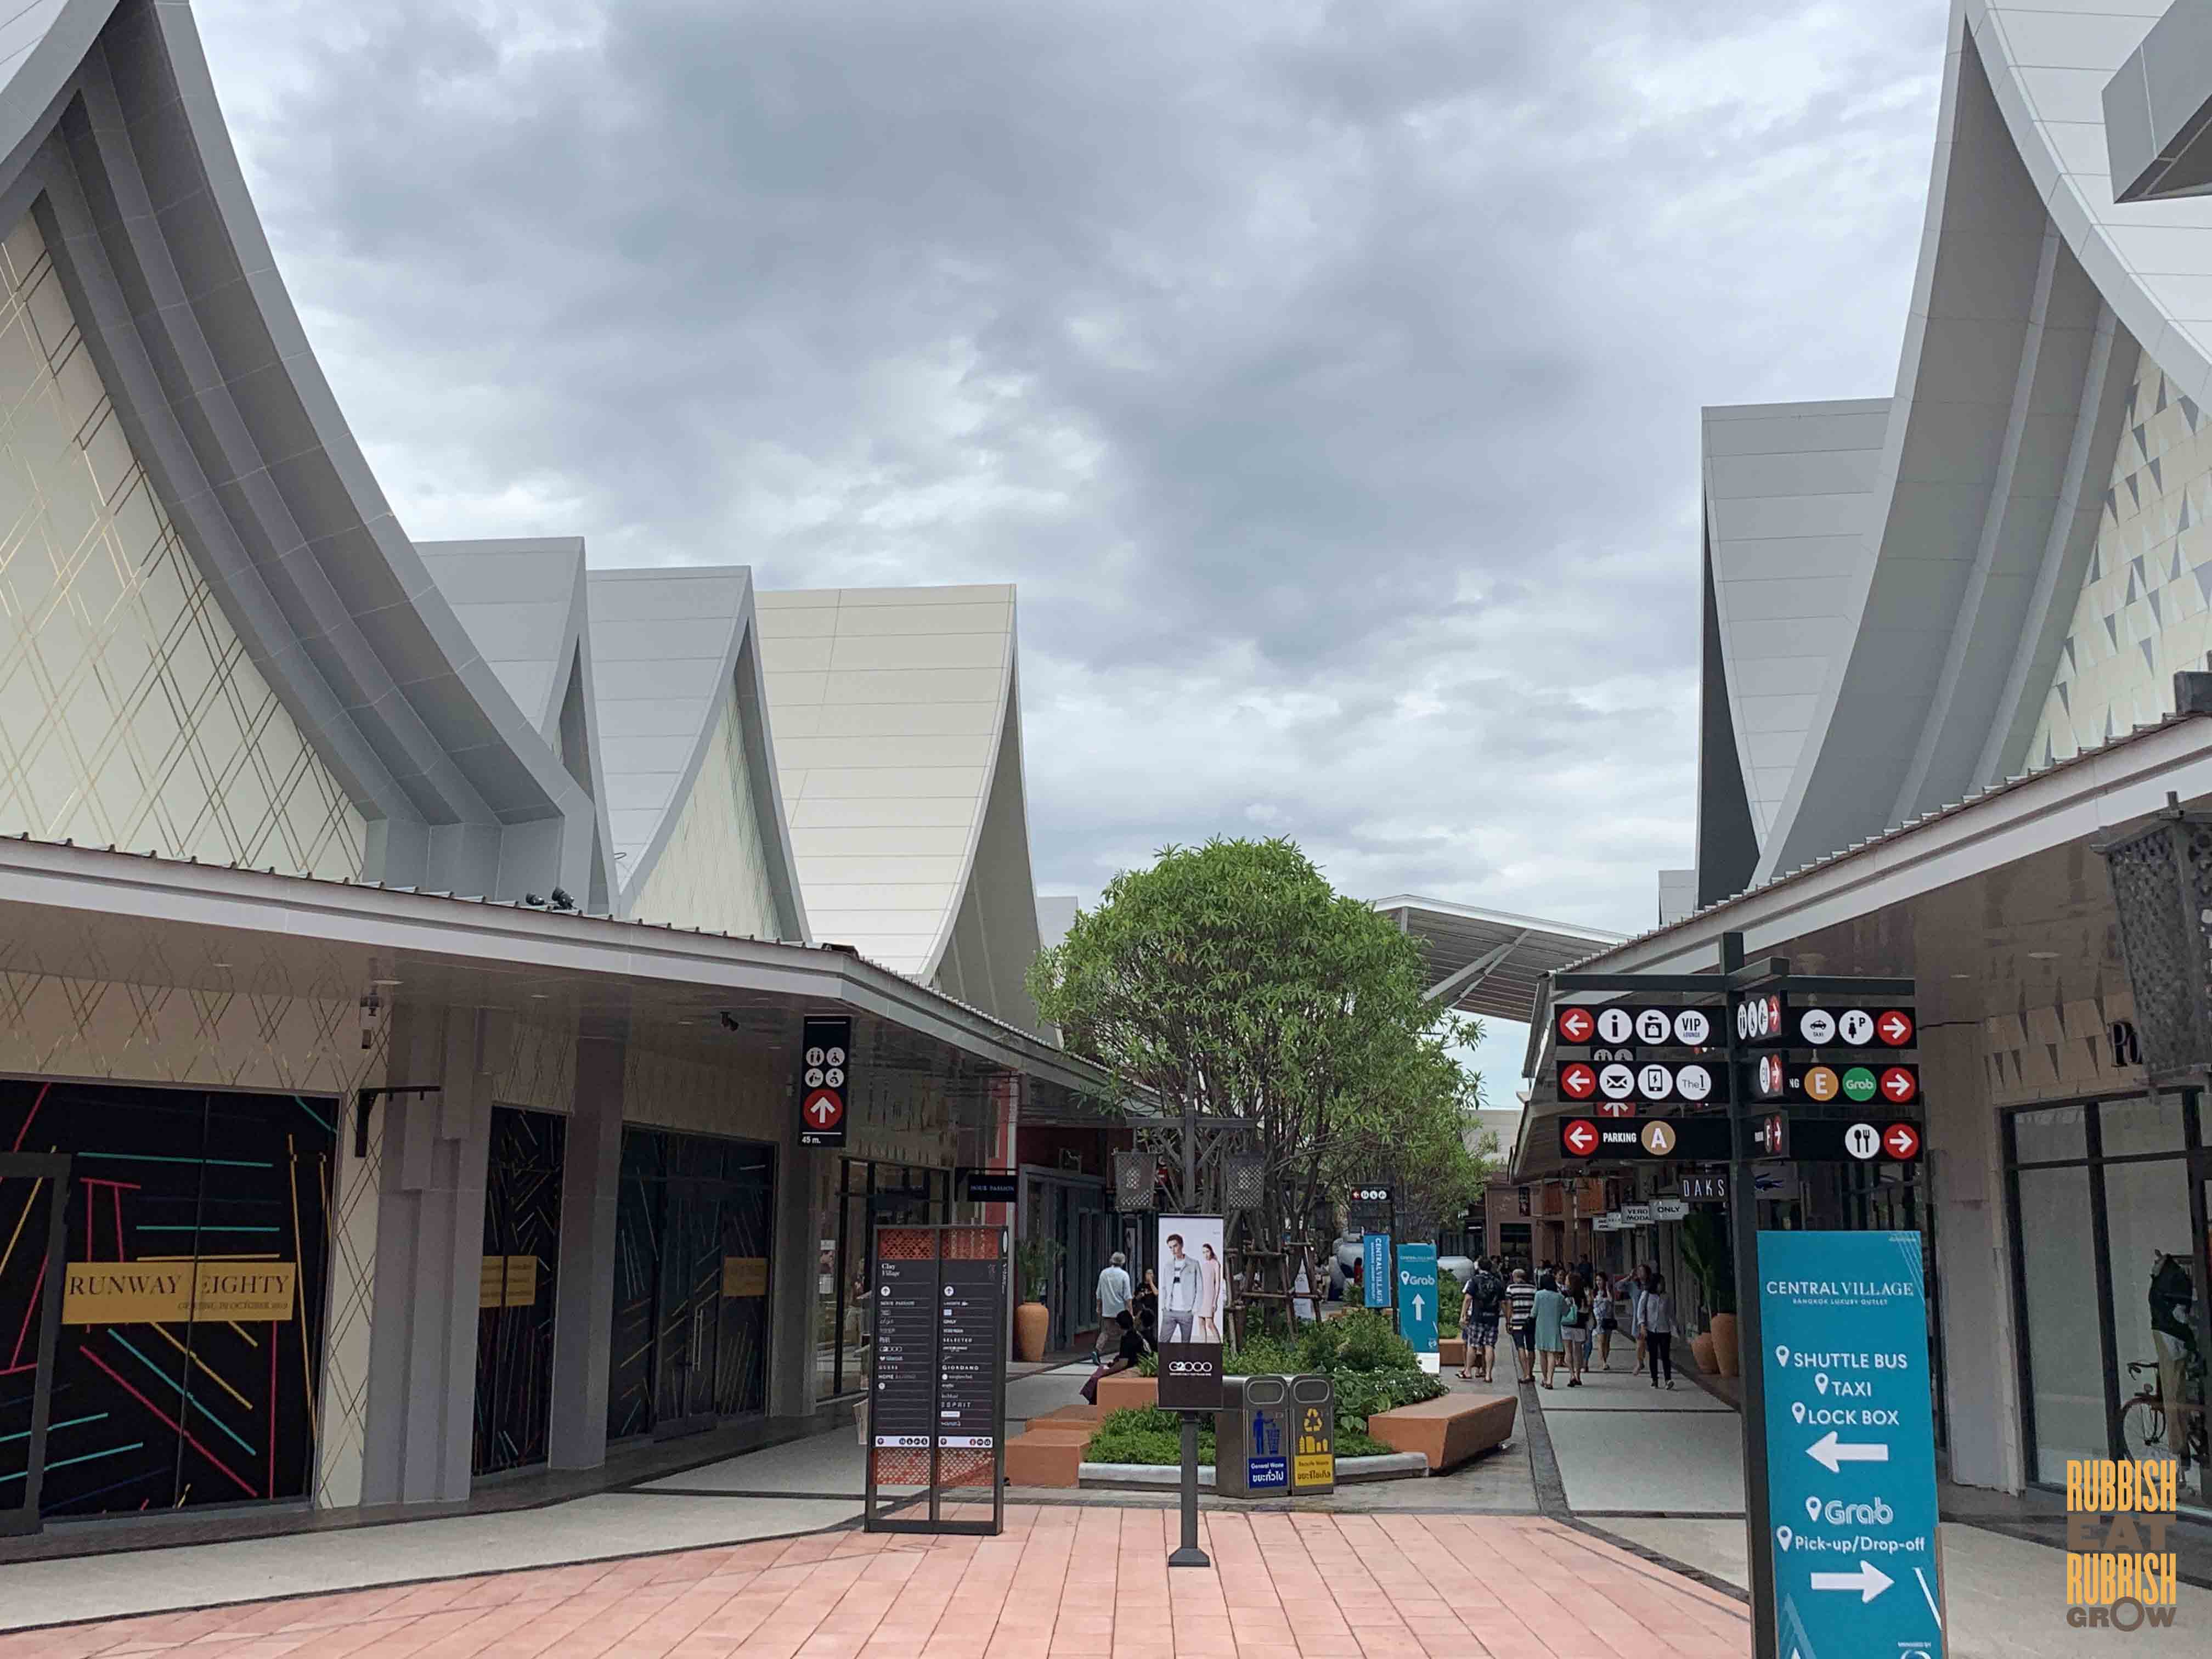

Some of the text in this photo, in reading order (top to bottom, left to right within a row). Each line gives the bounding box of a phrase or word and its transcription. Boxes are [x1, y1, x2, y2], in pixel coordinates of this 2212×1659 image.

[1681, 1018, 1701, 1031] VIP
[1859, 1017, 1865, 1026] P
[1815, 1073, 1827, 1094] E
[1846, 1079, 1874, 1090] Grab
[1602, 1127, 1667, 1149] PARKING A
[1683, 1179, 1725, 1197] DAKS
[70, 1274, 289, 1295] RUNWAY EIGHTY
[1409, 1274, 1435, 1285] Grab
[1766, 1281, 1914, 1297] CENTRAL VILLAGE
[1169, 1361, 1212, 1372] G2000
[1793, 1352, 1908, 1369] SHUTTLE BUS
[1831, 1380, 1872, 1397] TAXI
[1808, 1409, 1900, 1426] LOCK BOX
[1825, 1496, 1894, 1525] Grab
[1795, 1534, 1925, 1554] Pick-up/Drop-off
